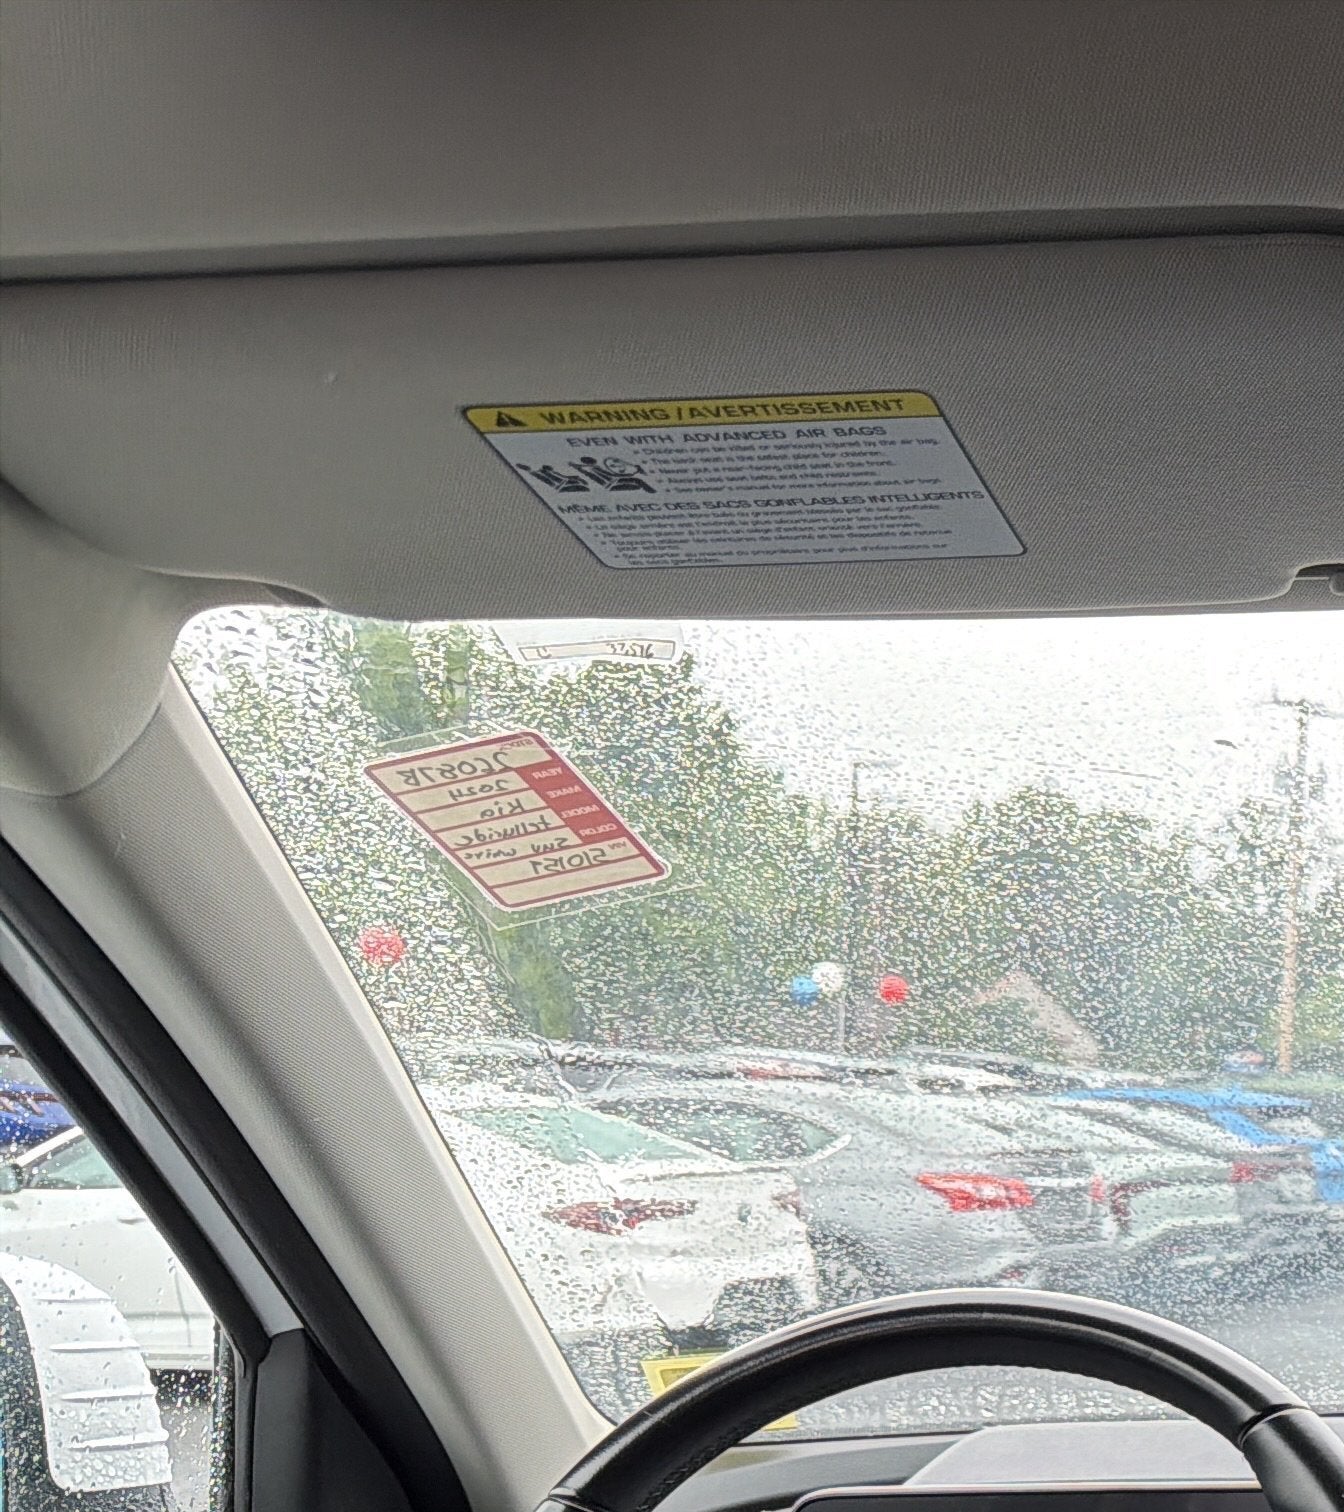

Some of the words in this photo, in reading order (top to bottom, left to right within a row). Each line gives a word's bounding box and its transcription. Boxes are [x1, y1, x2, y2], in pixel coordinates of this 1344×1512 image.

[566, 436, 618, 448] EVEN
[623, 434, 673, 445] WITH
[682, 428, 786, 443] ADVANCED
[796, 428, 825, 439] AIR
[834, 426, 887, 437] BAGS
[616, 502, 662, 513] AVEC
[665, 500, 699, 511] DES
[702, 499, 751, 510] SACS
[753, 494, 865, 508] GONFLABLES
[869, 490, 985, 504] INTELLIGENTS
